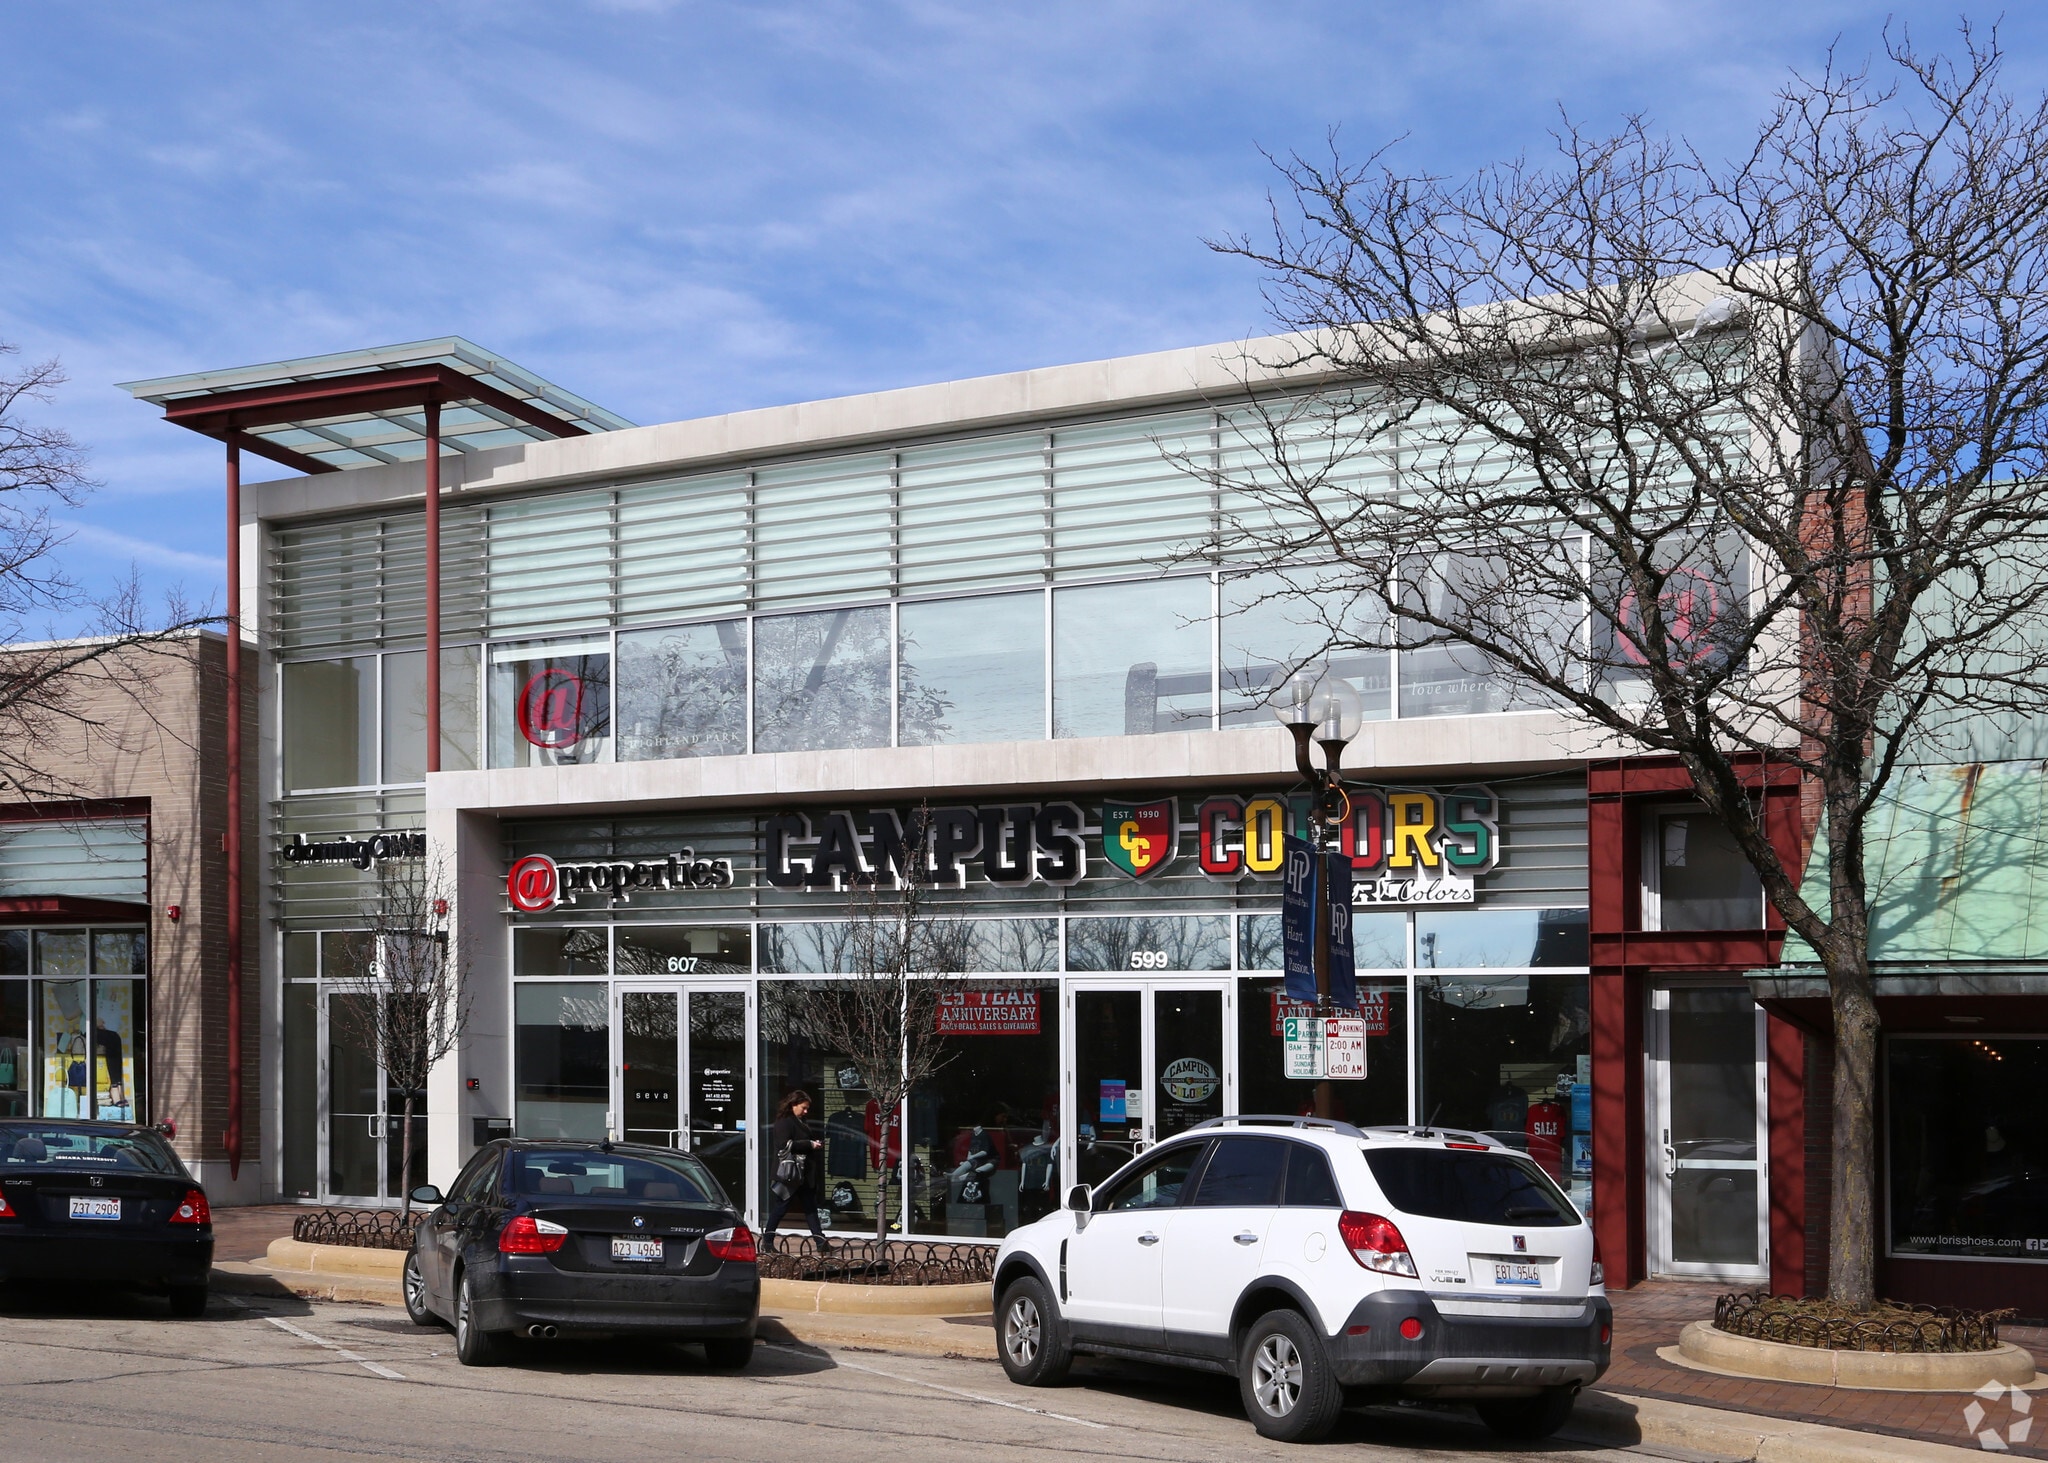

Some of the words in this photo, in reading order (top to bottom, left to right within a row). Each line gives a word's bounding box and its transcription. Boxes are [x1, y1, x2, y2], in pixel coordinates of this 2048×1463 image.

[1411, 682, 1442, 696] love
[1448, 679, 1492, 692] where
[630, 735, 699, 749] HIGHLAND
[706, 732, 740, 743] PARK
[1112, 811, 1133, 819] EST.
[1138, 810, 1160, 819] 1990
[765, 803, 1084, 889] CAMPUS
[508, 846, 733, 913] @properties
[1398, 878, 1472, 902] Colors
[667, 956, 698, 972] 607
[1130, 951, 1168, 969] 599
[941, 1007, 1037, 1021] ANNIVERSARY
[979, 1022, 997, 1030] SALES
[1286, 1022, 1296, 1037] 2
[1327, 1022, 1338, 1034] NO
[1339, 1025, 1363, 1033] PARKING
[1298, 1031, 1323, 1039] PARKING
[1288, 1043, 1302, 1051] 8AM
[1308, 1043, 1321, 1051] 7PM
[1330, 1041, 1347, 1050] 2:00
[1351, 1041, 1362, 1050] AM
[1341, 1052, 1351, 1062] TO
[1170, 1061, 1209, 1077] CAMPUS
[1330, 1064, 1348, 1074] 6:00
[1351, 1064, 1363, 1074] AM
[1170, 1083, 1209, 1099] COLORS
[72, 1202, 90, 1214] Z37
[95, 1202, 119, 1216] 2909
[1909, 1235, 2021, 1247] www.lorisshoes.com
[613, 1242, 631, 1256] A23
[637, 1243, 662, 1257] 4965
[1429, 1275, 1453, 1283] VUE
[1495, 1264, 1511, 1280] E87
[1517, 1265, 1539, 1281] 9546
